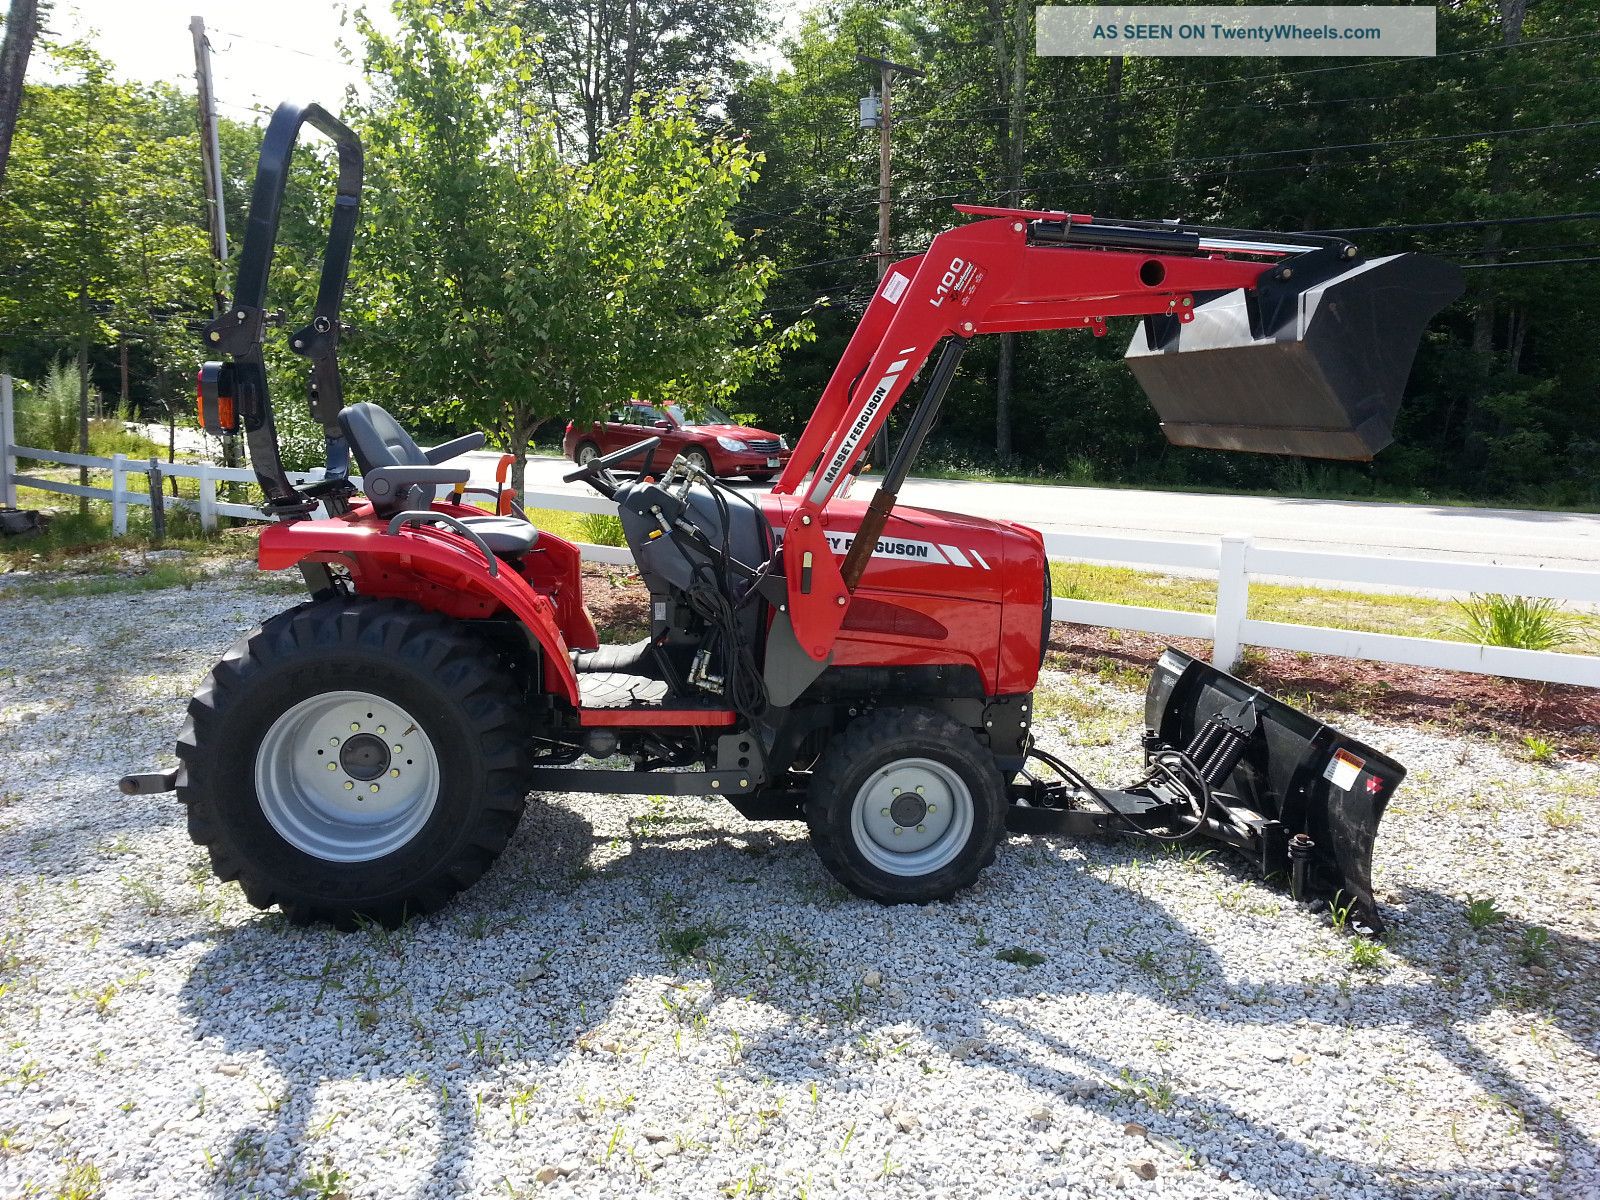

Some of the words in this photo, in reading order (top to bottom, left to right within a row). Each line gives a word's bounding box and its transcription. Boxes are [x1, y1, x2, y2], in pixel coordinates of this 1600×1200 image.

[929, 257, 964, 308] L100
[824, 441, 853, 484] MASSEY
[849, 386, 887, 442] FERGUSON
[845, 538, 928, 557] FGUSON
